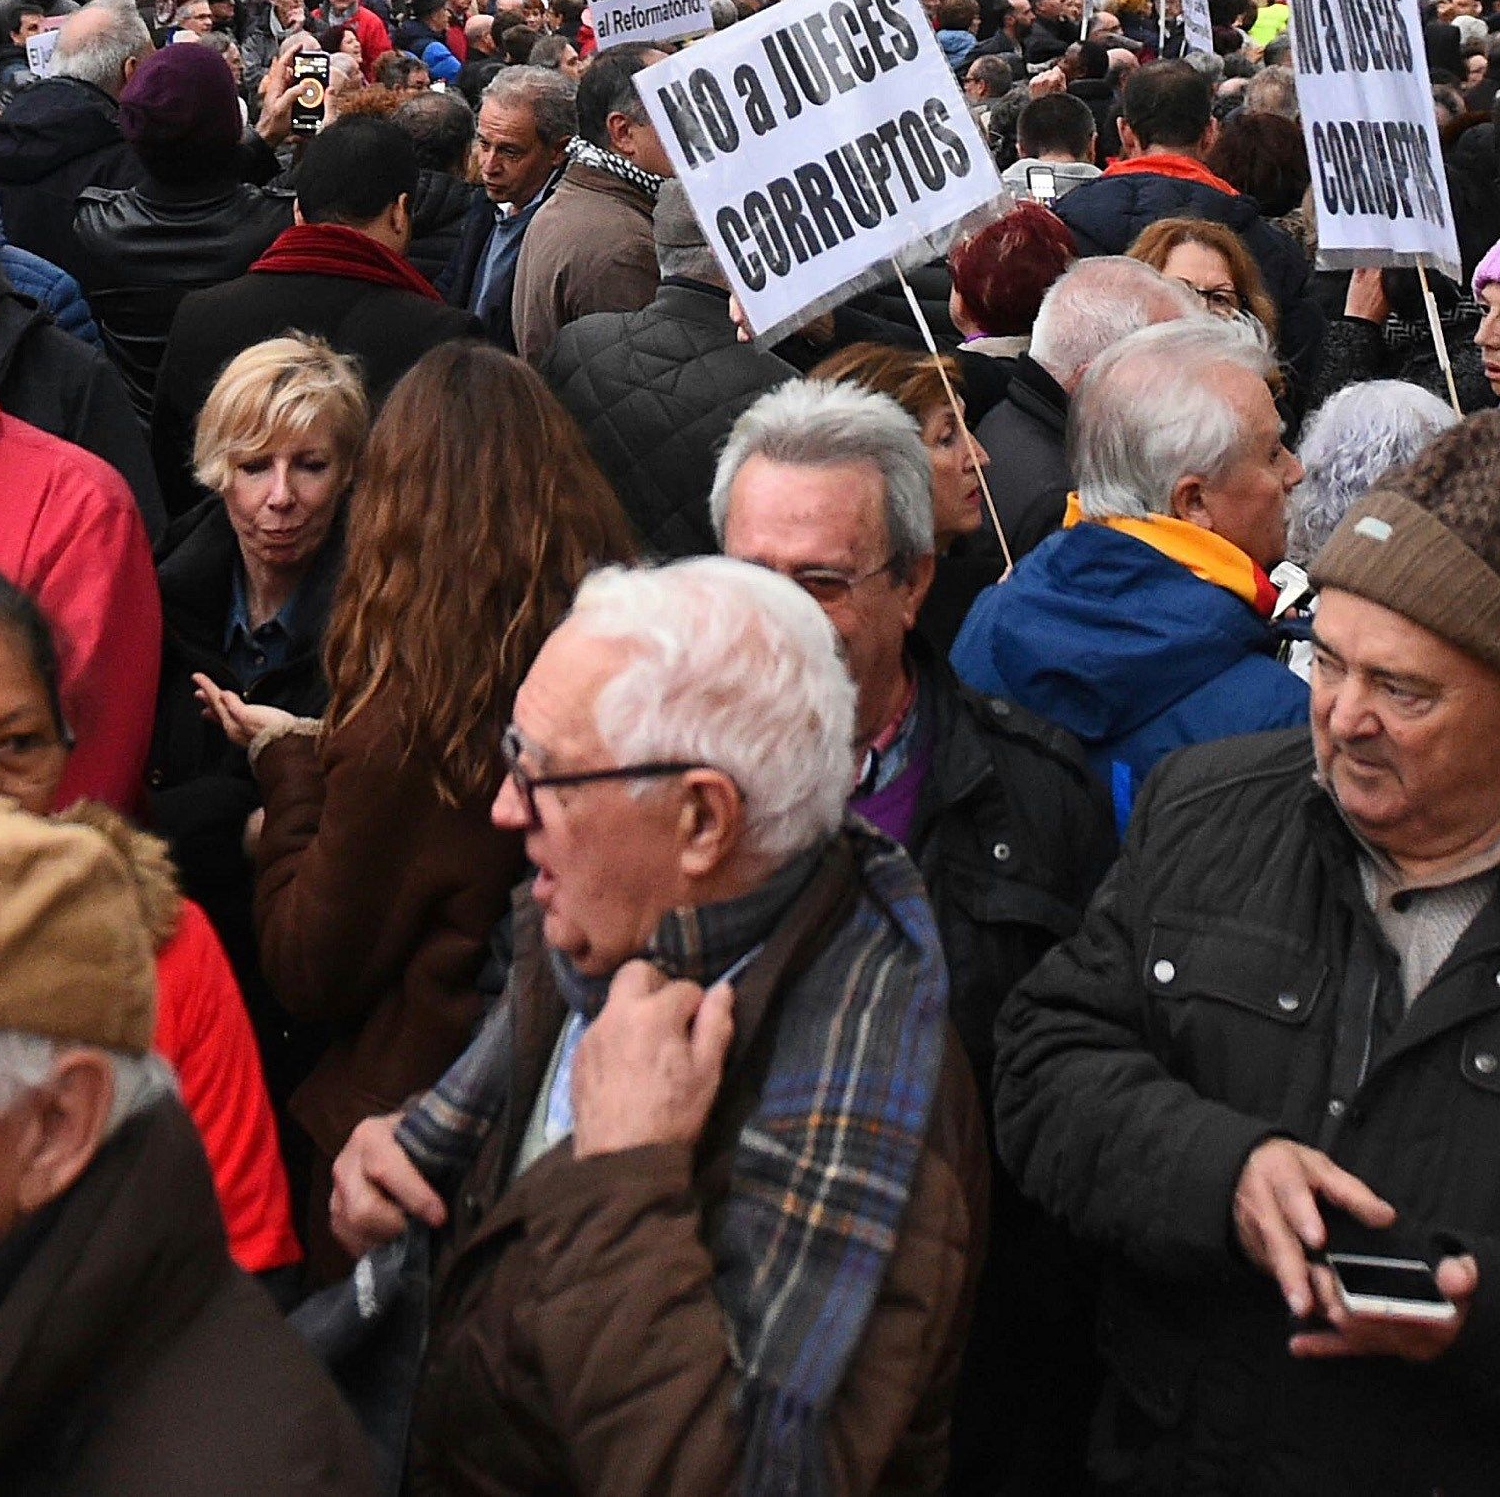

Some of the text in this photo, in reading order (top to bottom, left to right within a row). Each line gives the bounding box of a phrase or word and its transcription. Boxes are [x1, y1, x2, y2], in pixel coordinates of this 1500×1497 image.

[596, 12, 611, 39] al
[657, 67, 741, 171] NO
[733, 63, 778, 138] a
[715, 97, 973, 293] CORRUPTOS
